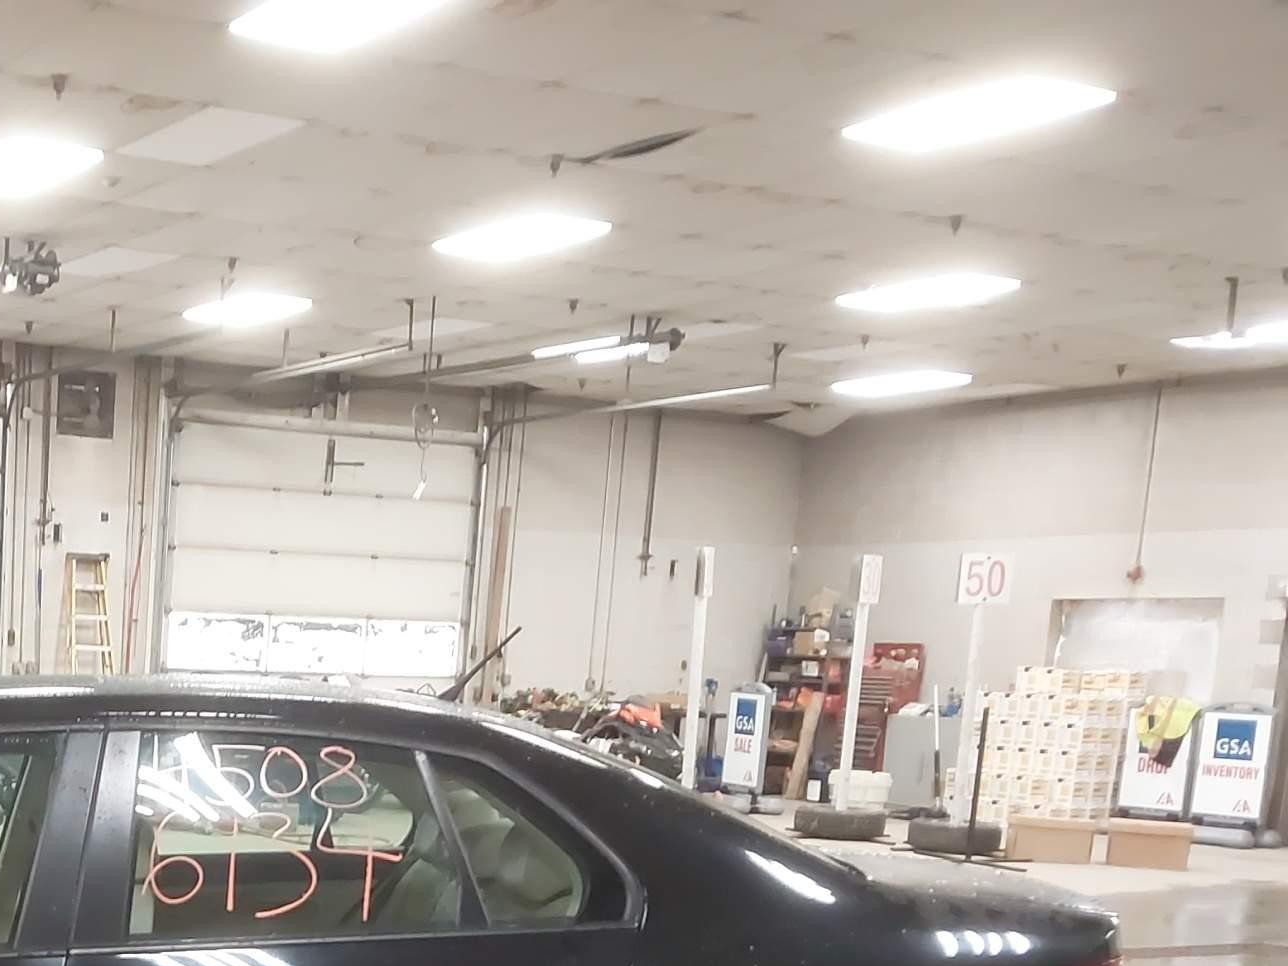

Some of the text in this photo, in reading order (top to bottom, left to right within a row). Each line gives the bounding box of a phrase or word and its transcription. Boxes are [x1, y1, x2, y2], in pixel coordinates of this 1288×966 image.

[966, 560, 1006, 597] 50
[736, 715, 754, 732] GSA
[734, 736, 752, 753] SALE
[1215, 737, 1252, 755] GSA
[1202, 764, 1259, 779] INVENTORY
